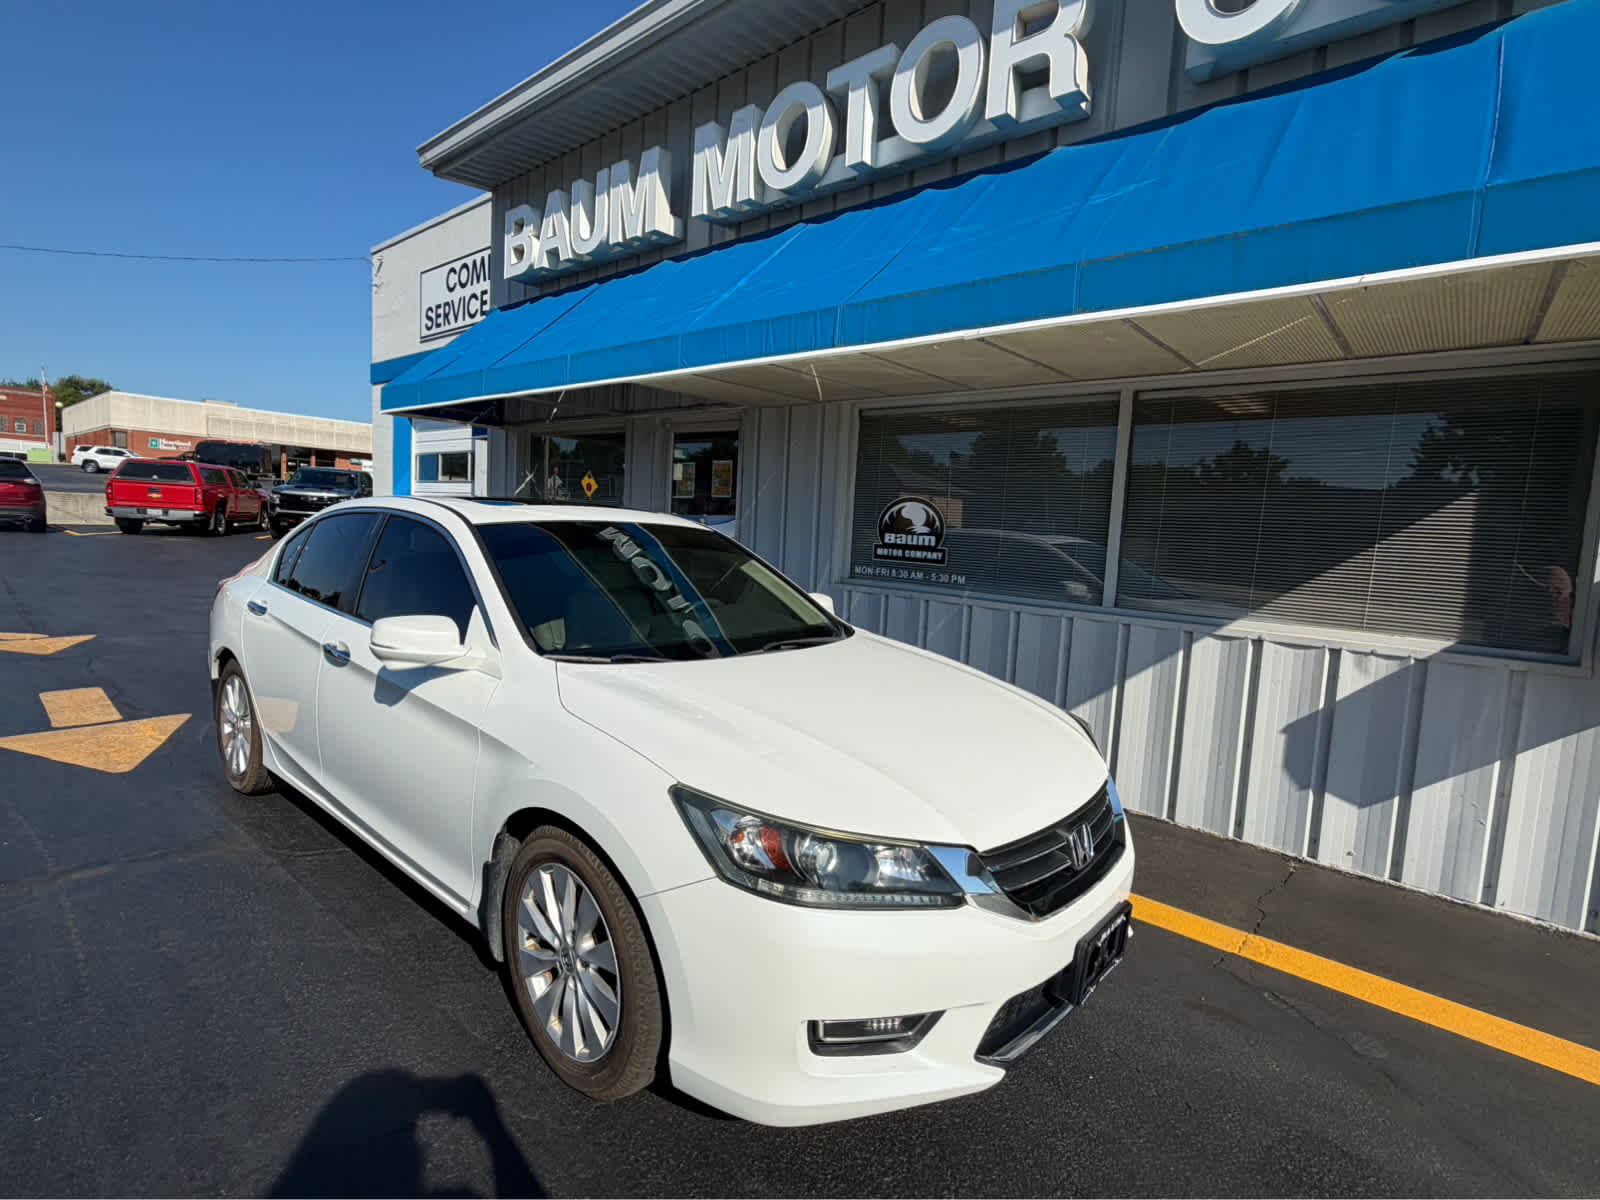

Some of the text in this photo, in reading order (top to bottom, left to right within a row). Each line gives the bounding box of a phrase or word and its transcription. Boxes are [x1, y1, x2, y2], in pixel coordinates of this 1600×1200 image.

[503, 0, 1092, 283] BAUM MOTOR
[446, 254, 490, 292] COM
[425, 290, 488, 331] SERVICE
[876, 547, 943, 560] MOTOR COMPANY
[950, 574, 966, 584] PM
